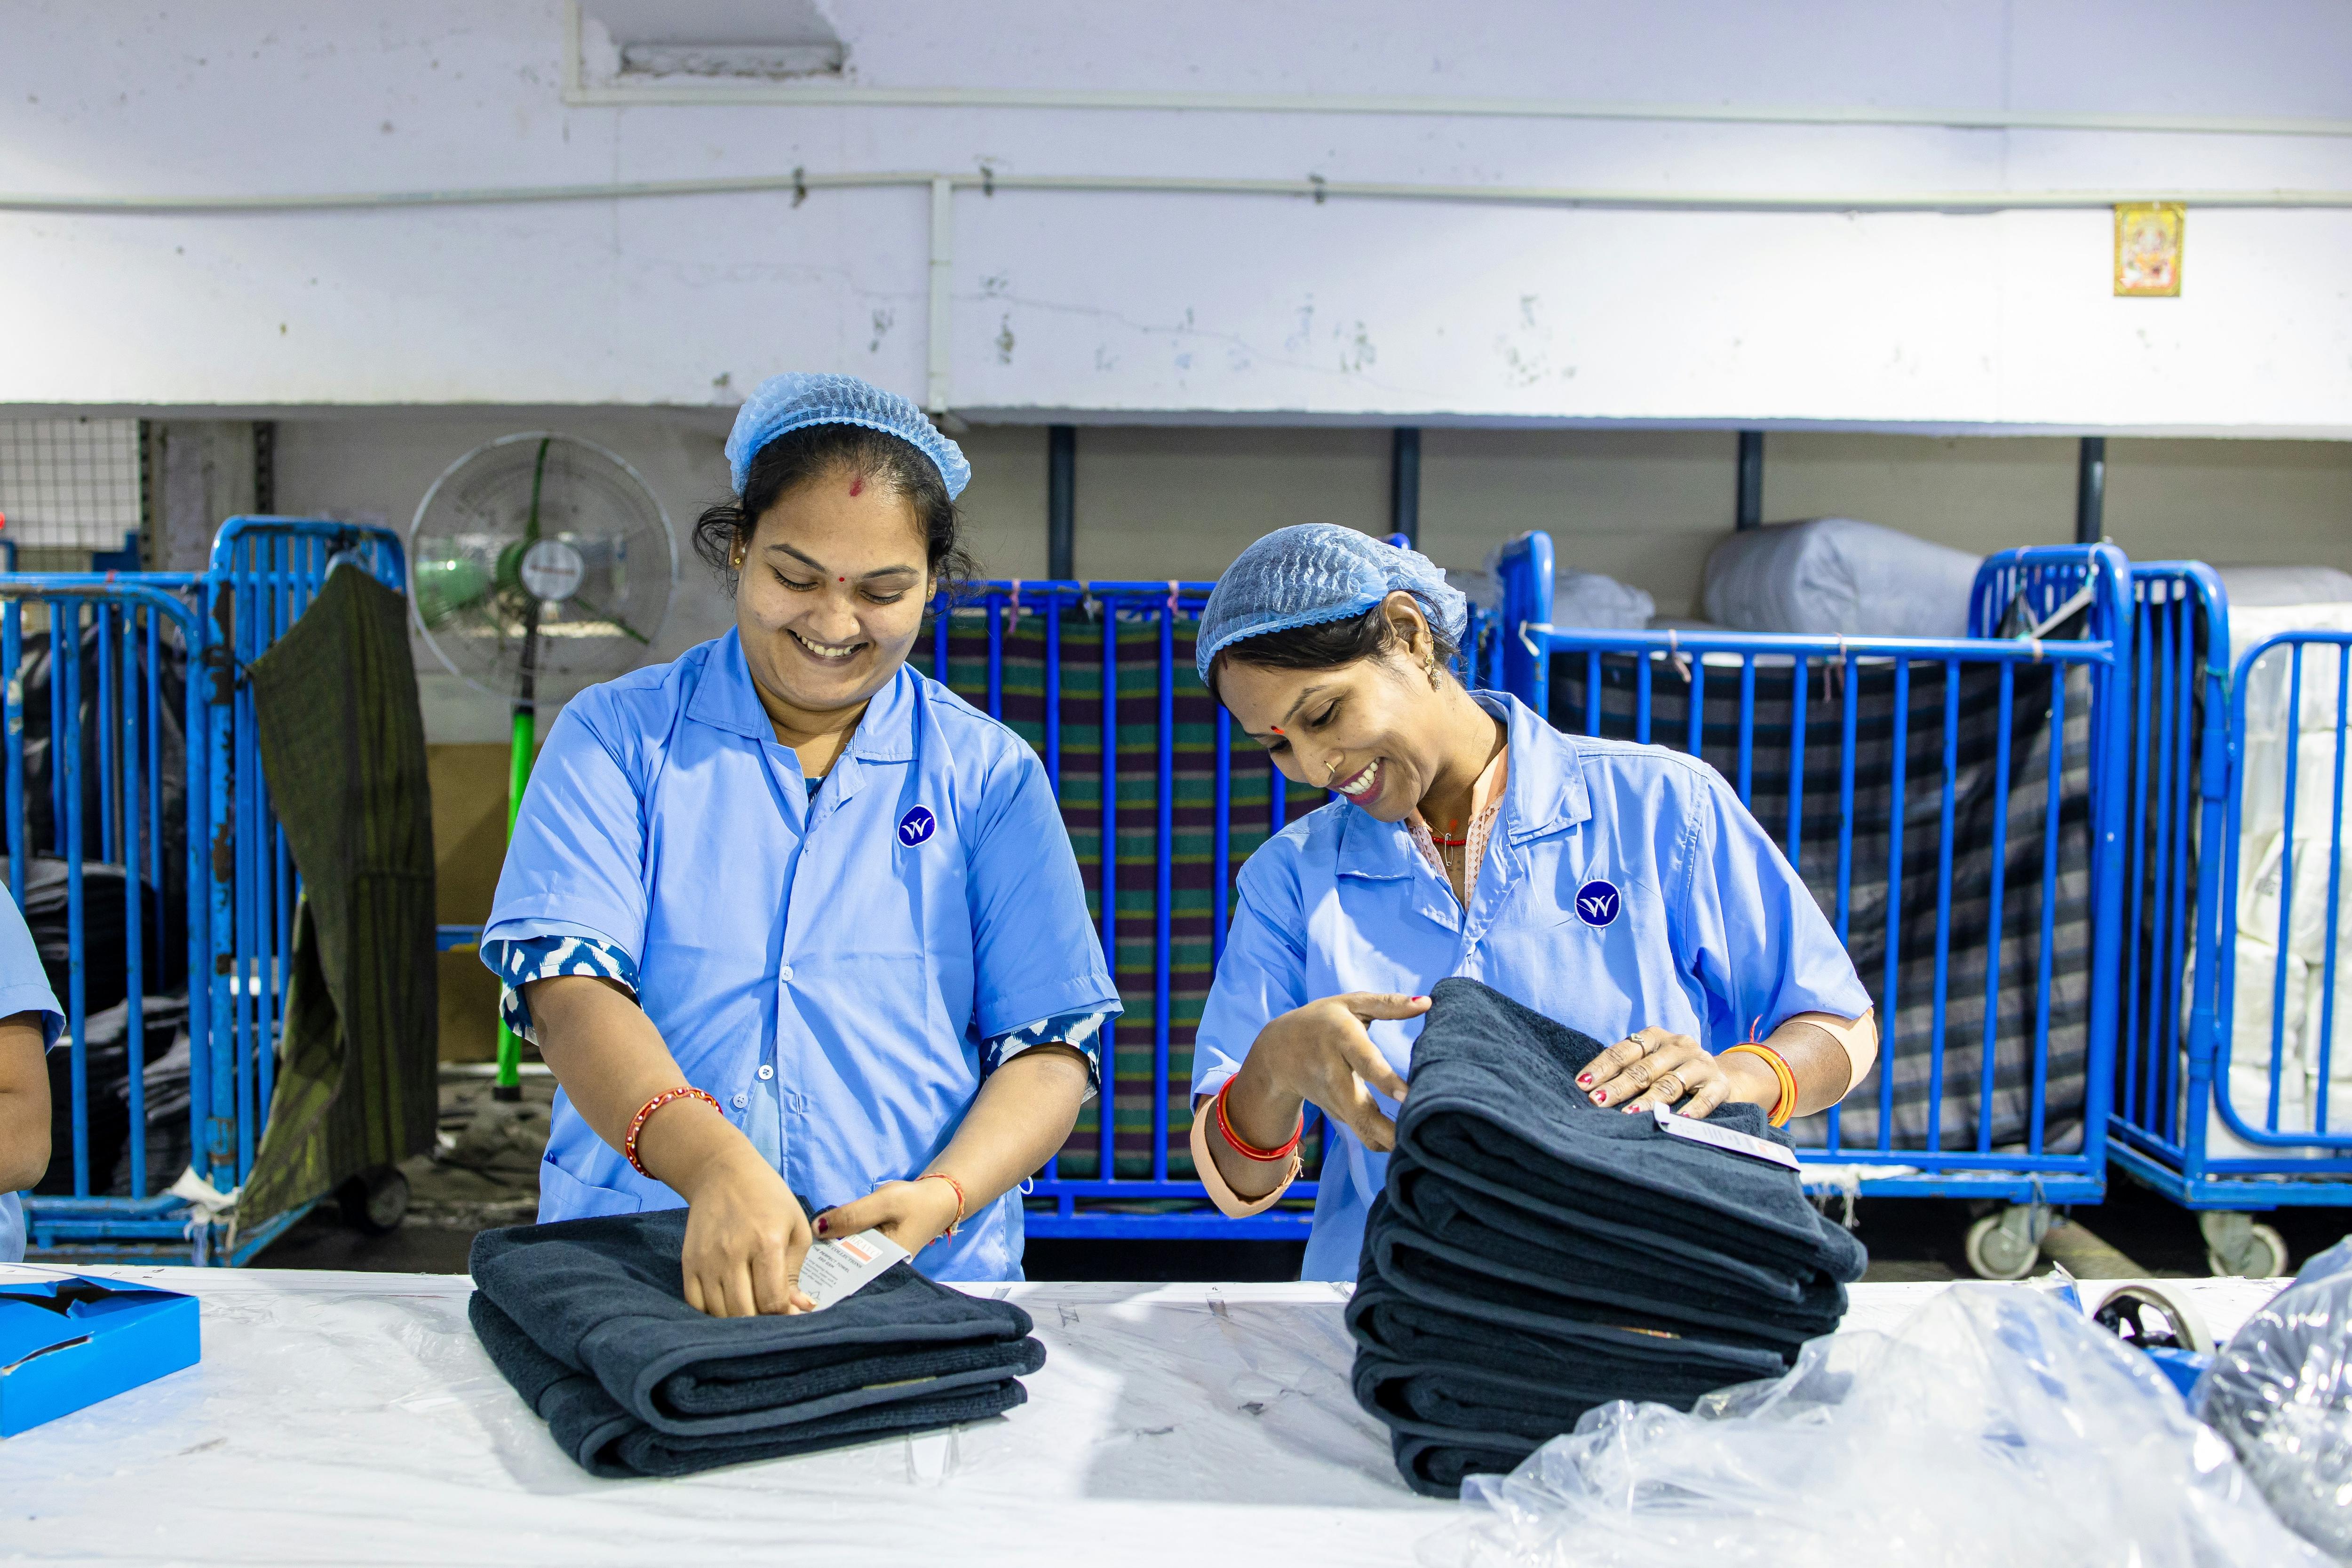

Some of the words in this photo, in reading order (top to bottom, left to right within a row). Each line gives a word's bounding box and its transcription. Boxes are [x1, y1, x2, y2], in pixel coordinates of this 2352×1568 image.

[819, 1250, 837, 1264] PERFECT
[836, 1262, 850, 1273] TOWEL
[831, 1246, 863, 1269] COLLECTIONS
